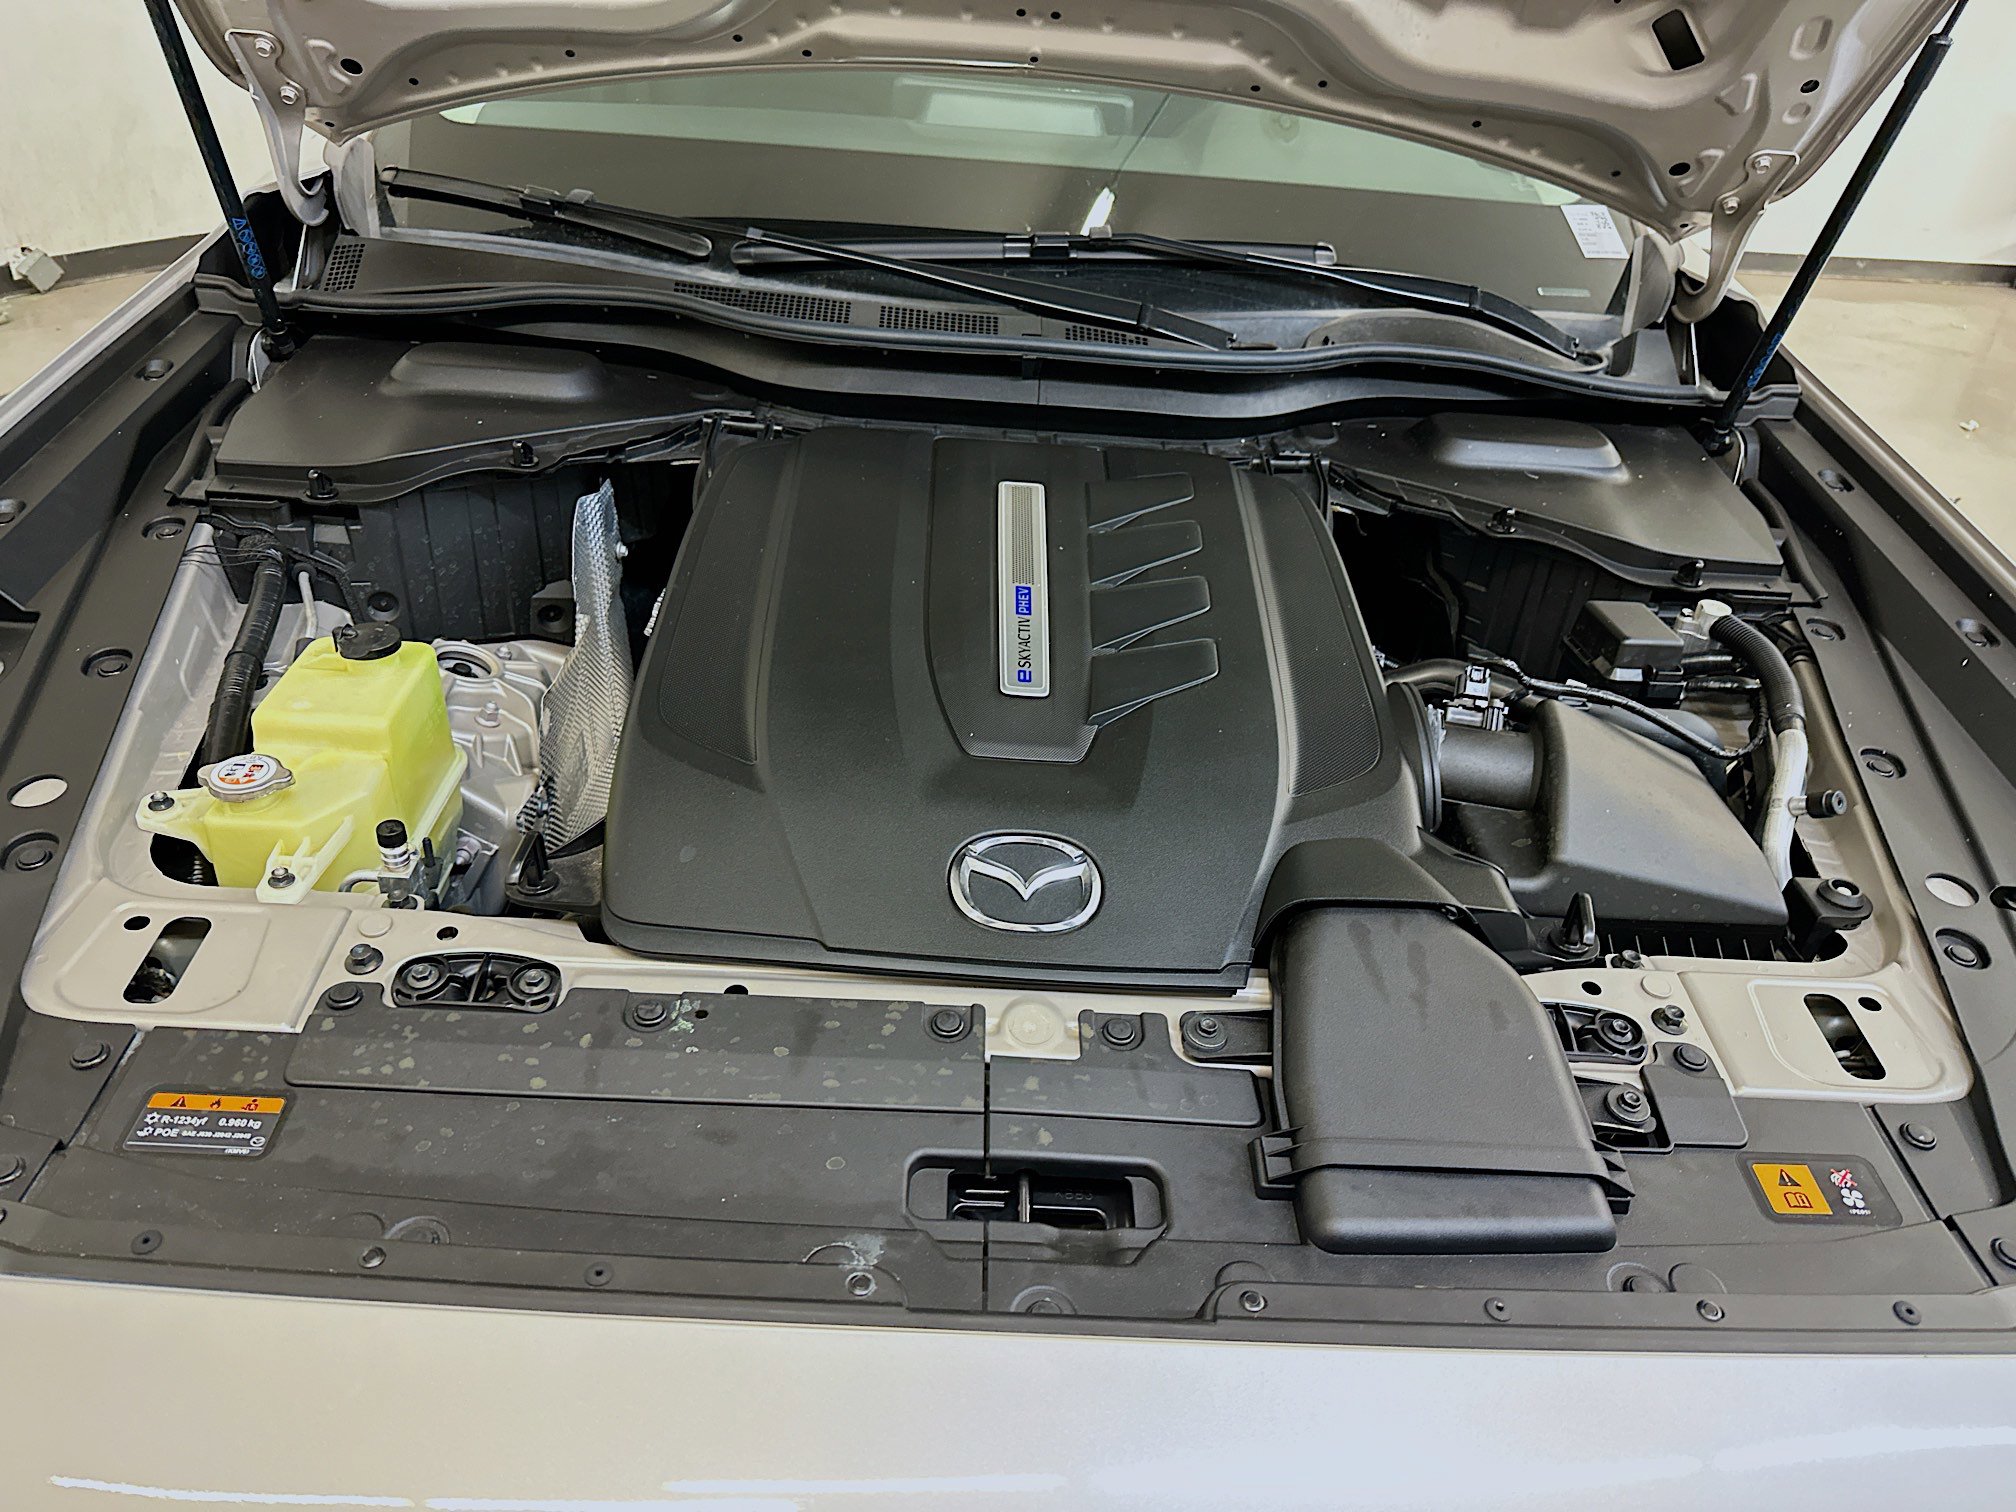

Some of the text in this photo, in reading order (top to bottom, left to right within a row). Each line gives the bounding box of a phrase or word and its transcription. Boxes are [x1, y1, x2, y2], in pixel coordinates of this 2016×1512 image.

[1018, 587, 1030, 614] PHEV
[1018, 617, 1032, 669] SKYACTIV
[161, 1115, 208, 1127] R-1234yf
[247, 1118, 262, 1129] kg
[154, 1127, 180, 1138] POE
